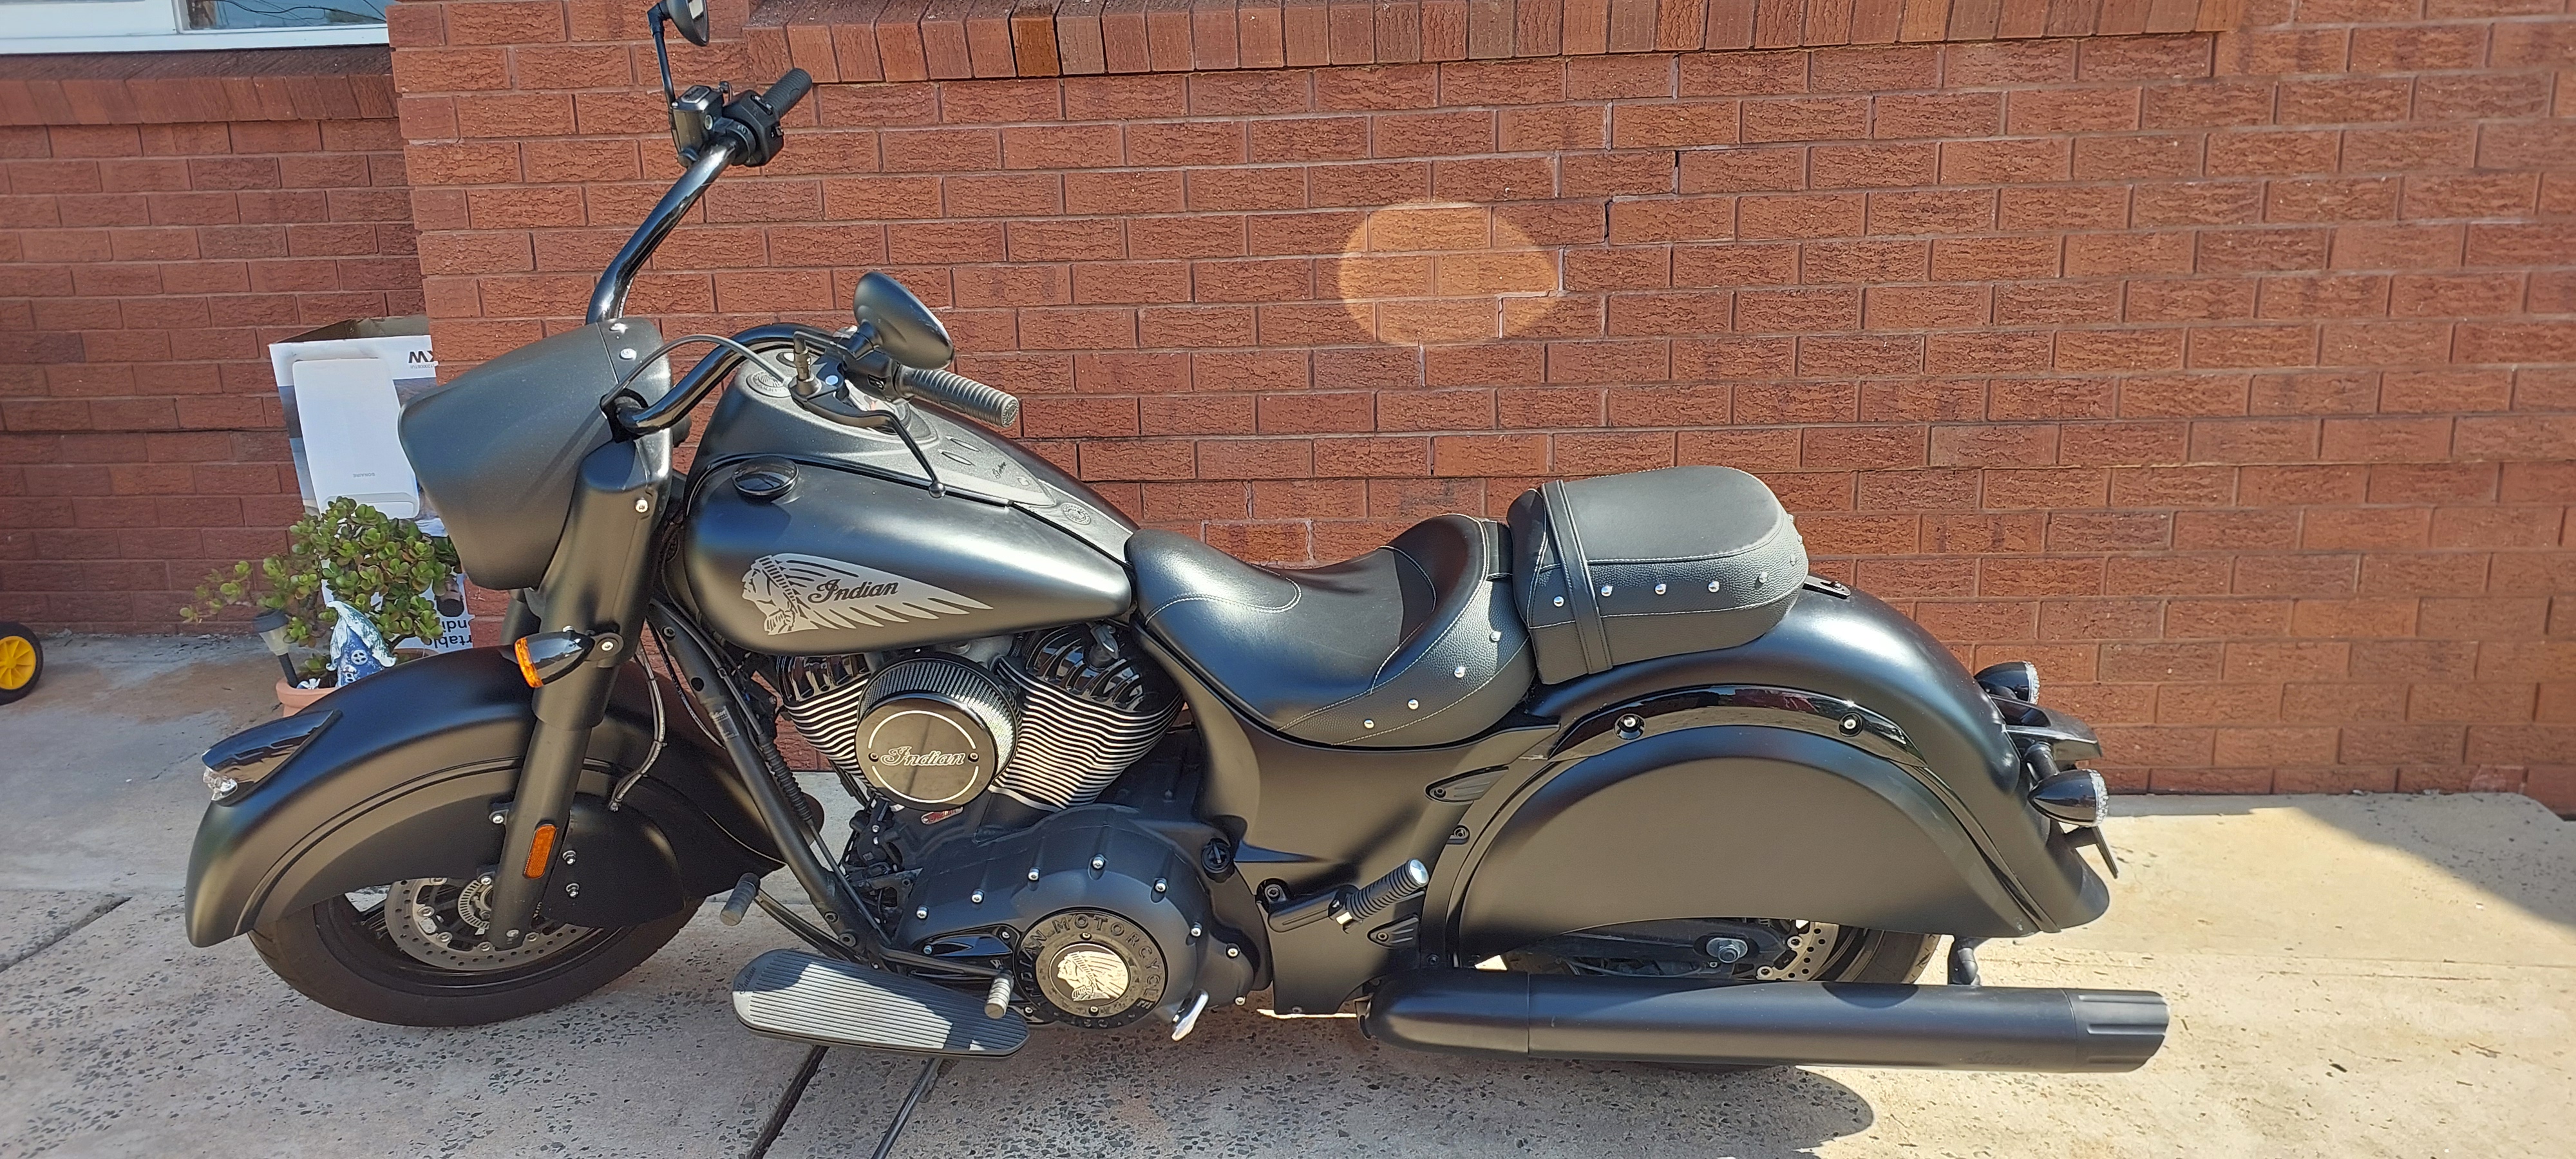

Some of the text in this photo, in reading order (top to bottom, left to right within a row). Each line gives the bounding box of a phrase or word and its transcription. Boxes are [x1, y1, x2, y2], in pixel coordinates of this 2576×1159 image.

[808, 578, 899, 603] Indian
[441, 619, 471, 633] ndi
[880, 746, 965, 766] Indian
[1051, 913, 1161, 1010] MOTORCYCLE
[737, 966, 757, 995] Indian
